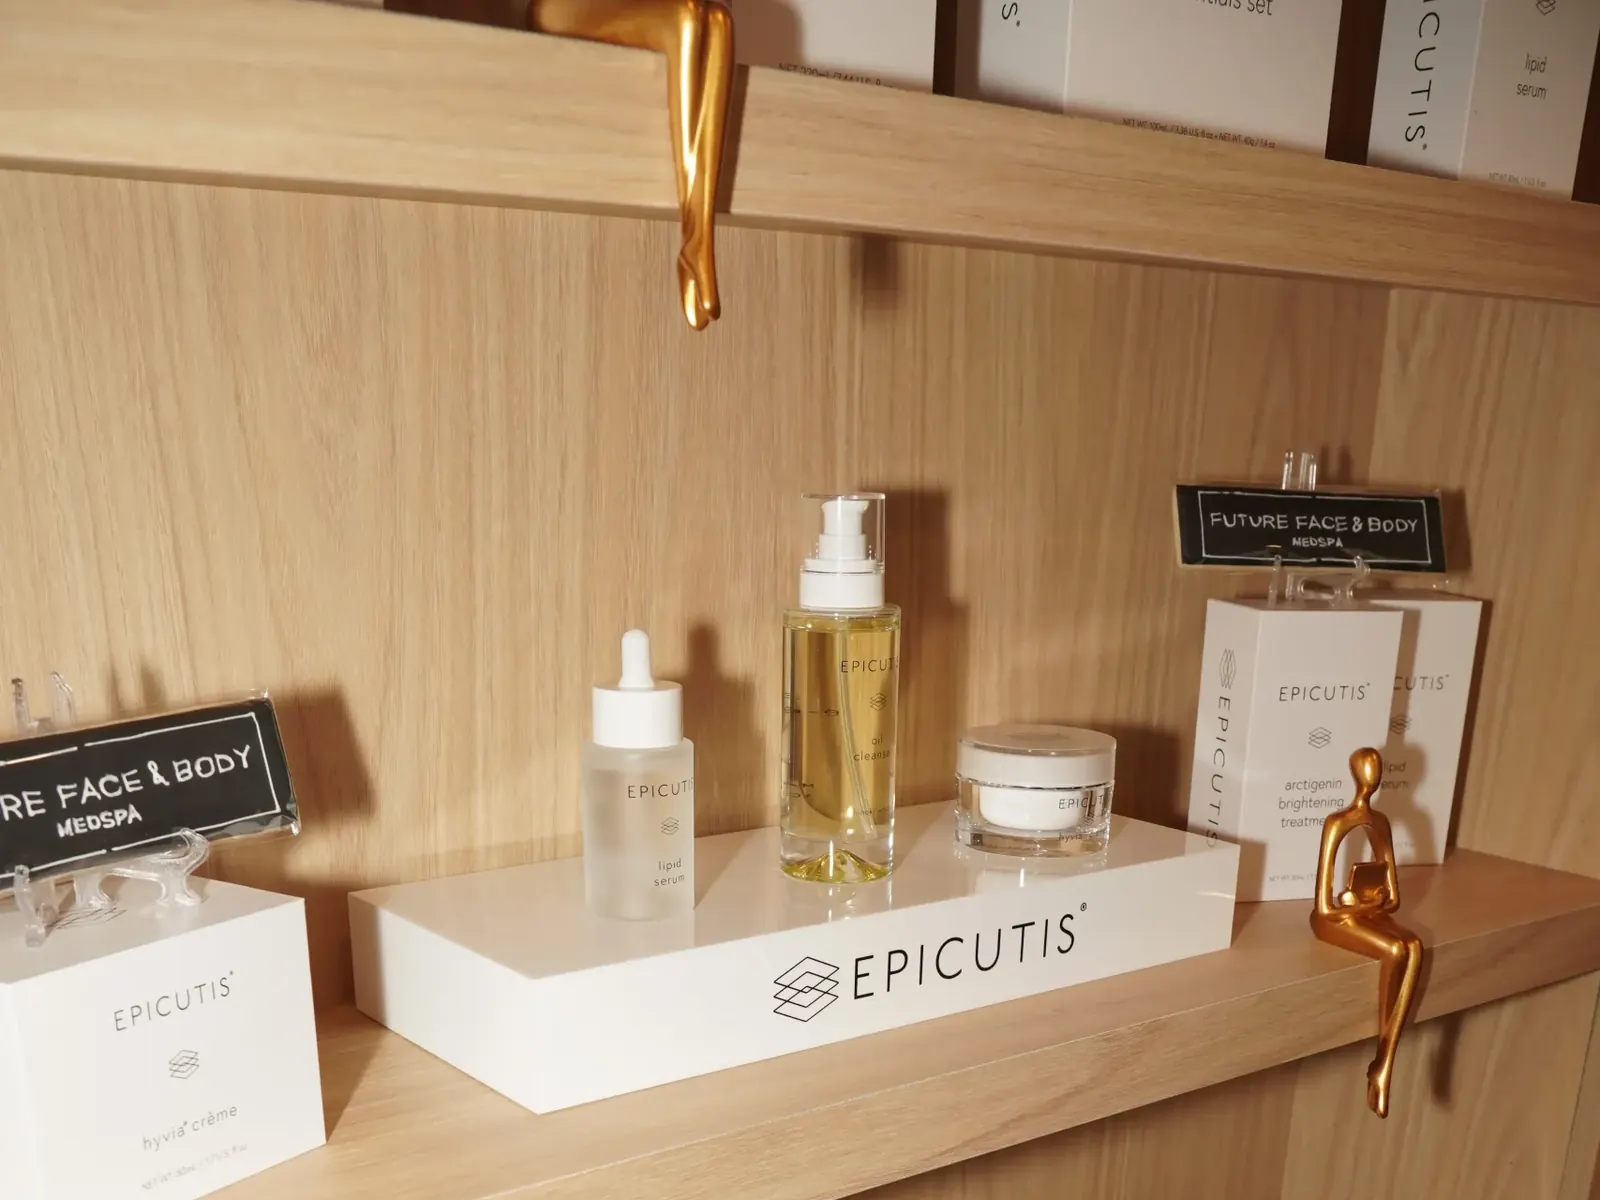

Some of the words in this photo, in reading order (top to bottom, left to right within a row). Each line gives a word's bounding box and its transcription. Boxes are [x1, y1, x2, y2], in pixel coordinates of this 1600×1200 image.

[1524, 52, 1548, 75] lipid
[1516, 83, 1547, 99] serum
[1210, 513, 1288, 529] FUTURE
[1296, 515, 1348, 532] FACE
[1352, 516, 1363, 533] &
[1368, 516, 1418, 533] BODY
[1292, 536, 1343, 548] MEDSPA
[871, 732, 883, 746] oil
[56, 768, 144, 809] FACE
[147, 760, 170, 786] &
[172, 744, 250, 783] BODY
[1284, 778, 1342, 793] arctigenin
[1381, 780, 1409, 790] erum
[1278, 796, 1345, 812] brightening
[57, 803, 143, 838] MEDSPA
[1281, 816, 1326, 829] treatme
[658, 857, 682, 873] lipid
[653, 873, 685, 887] serum
[192, 1105, 238, 1132] crème
